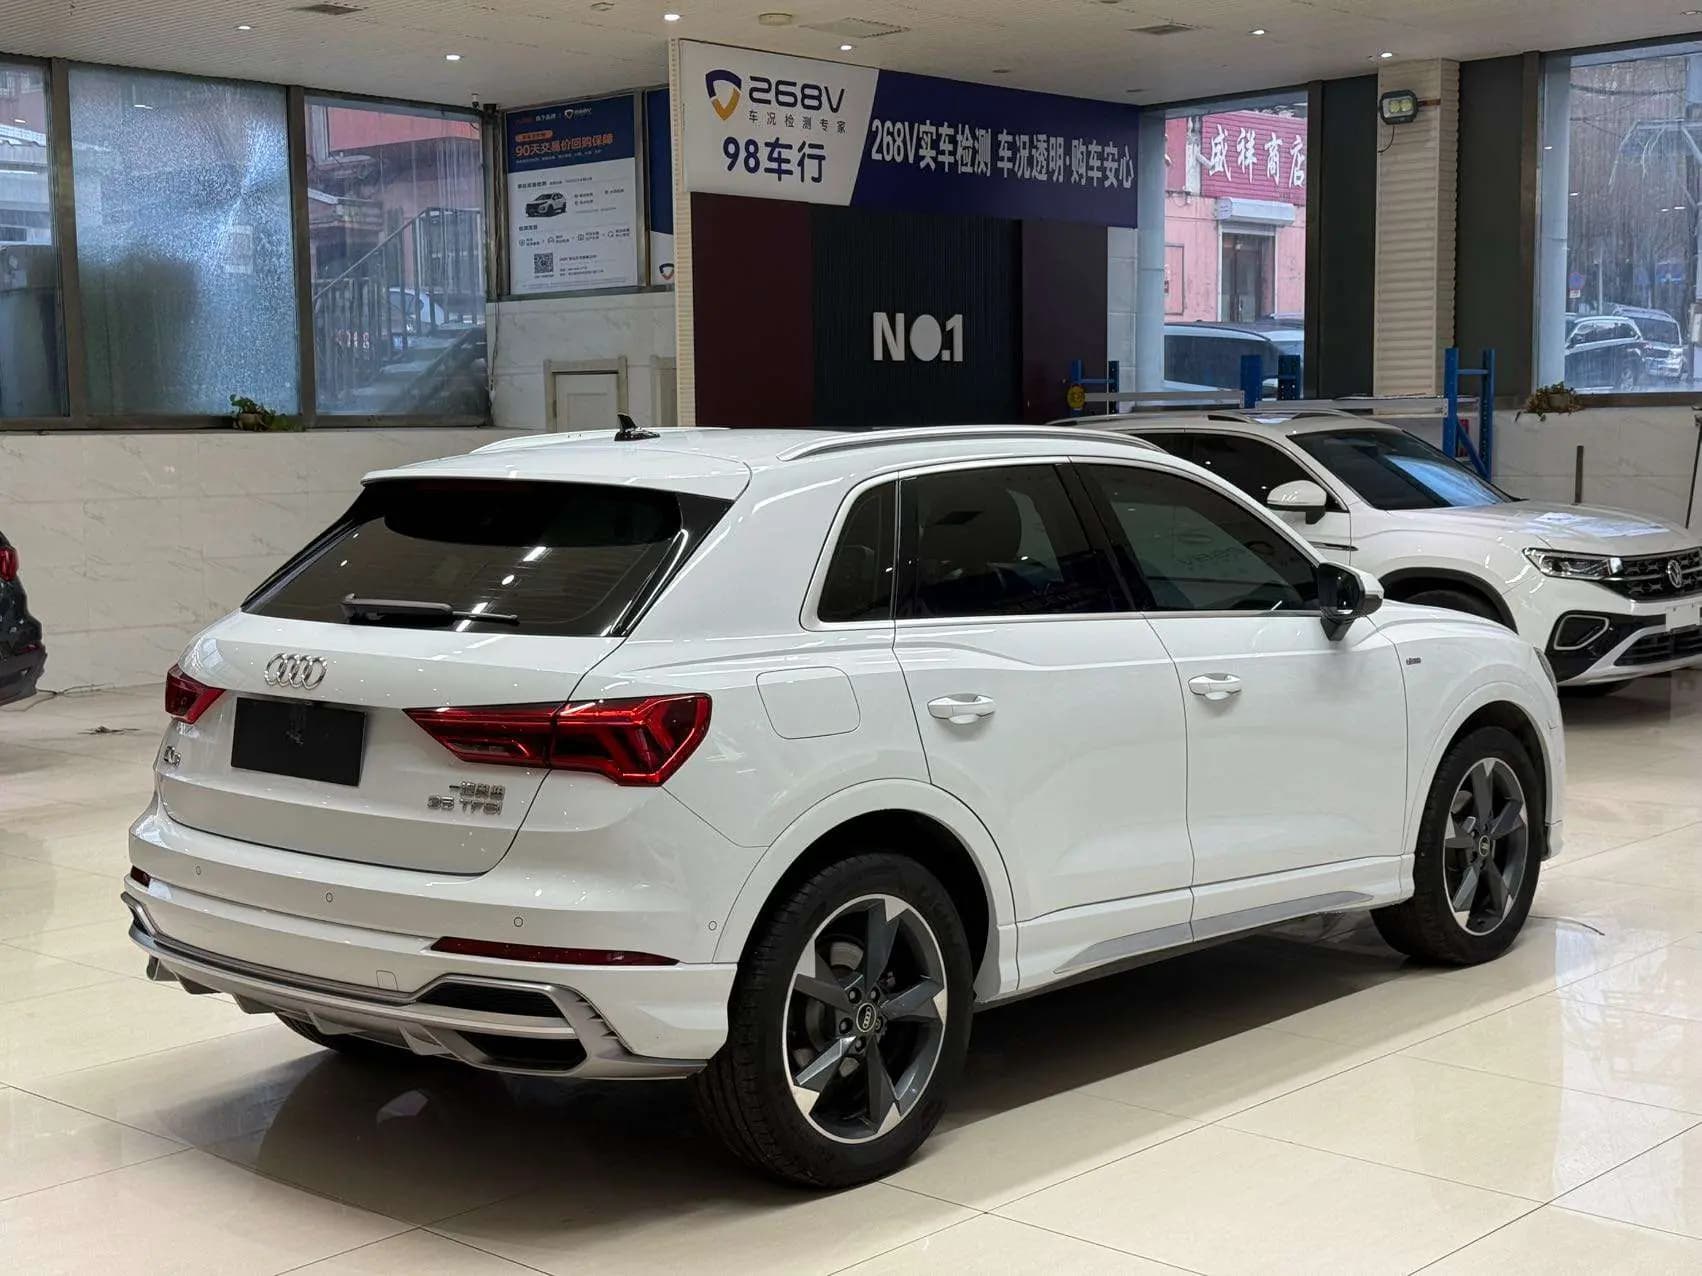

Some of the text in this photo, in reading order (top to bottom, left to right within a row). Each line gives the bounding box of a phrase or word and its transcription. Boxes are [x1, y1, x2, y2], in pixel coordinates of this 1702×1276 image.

[748, 75, 845, 113] 268V
[748, 110, 846, 134] 车况检测专家
[723, 136, 826, 183] 98车行
[871, 118, 1135, 189] 268V实车检测 车况透明·购车安心
[460, 798, 504, 816] TFSI
